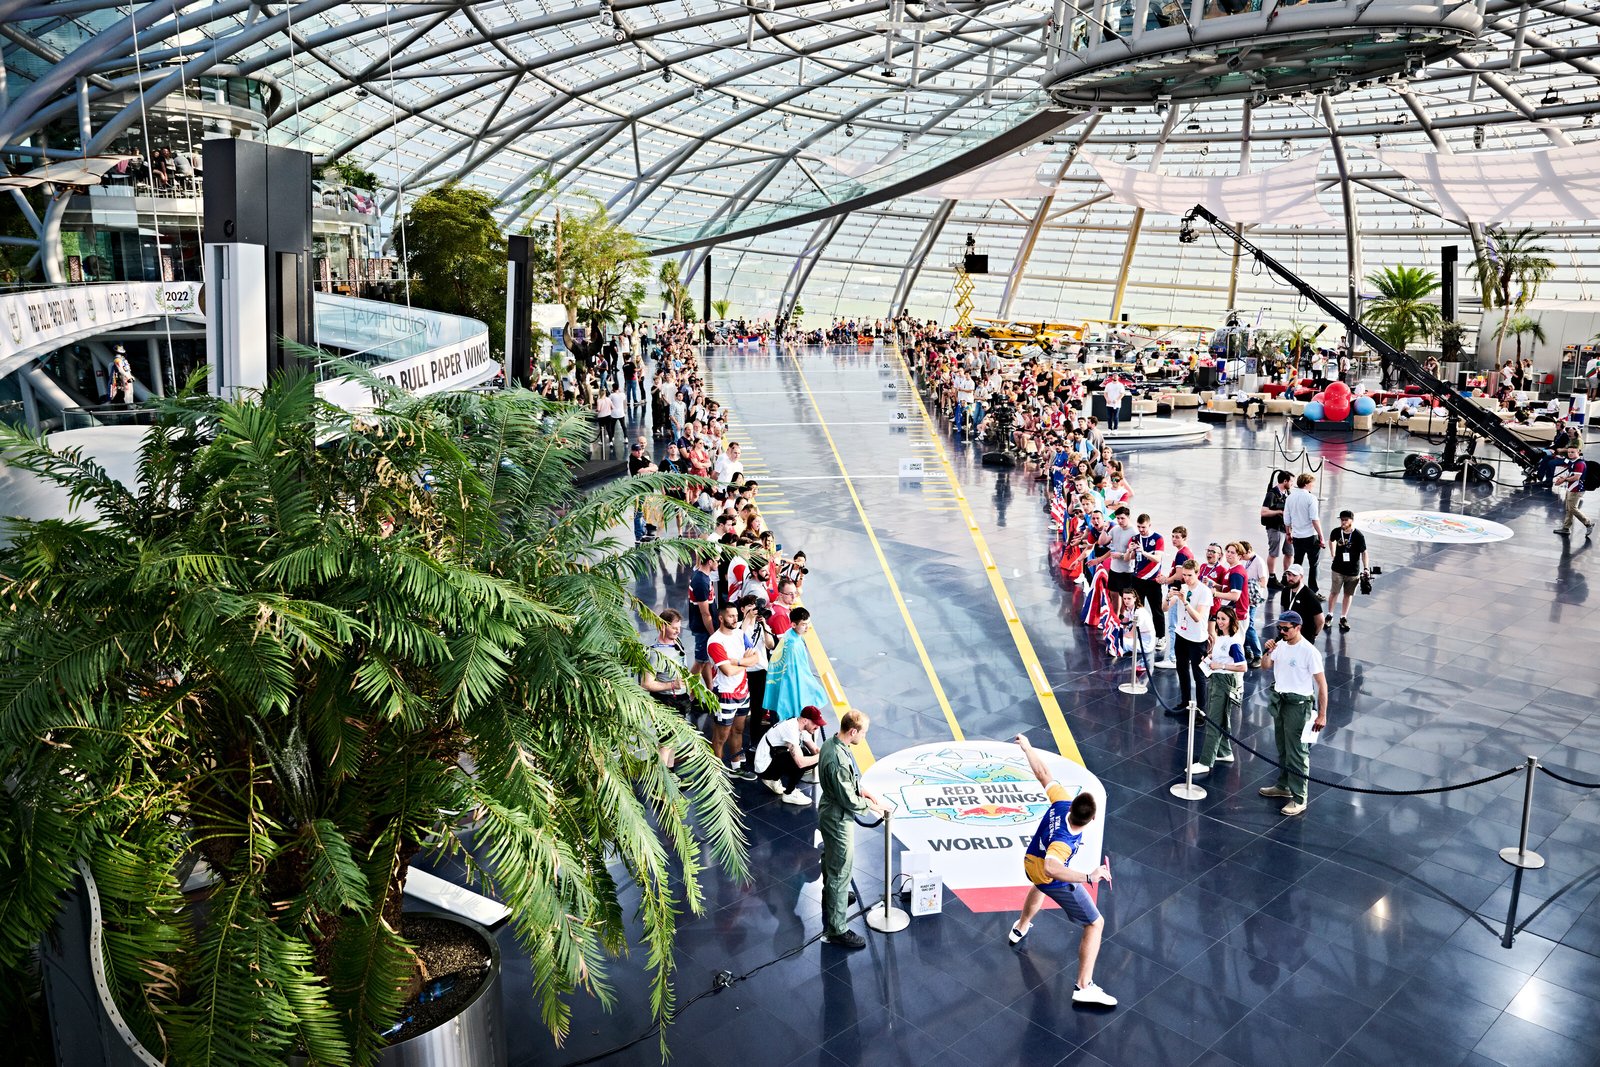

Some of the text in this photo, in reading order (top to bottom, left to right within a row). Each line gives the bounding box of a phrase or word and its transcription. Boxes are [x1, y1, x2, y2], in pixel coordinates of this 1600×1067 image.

[165, 291, 189, 302] 2022
[400, 364, 429, 391] BULL
[430, 352, 462, 384] PAPER
[463, 340, 488, 370] WINGS
[942, 784, 1022, 795] RED BULL
[925, 793, 1048, 806] PAPER WINGS
[928, 836, 1013, 852] WORLD
